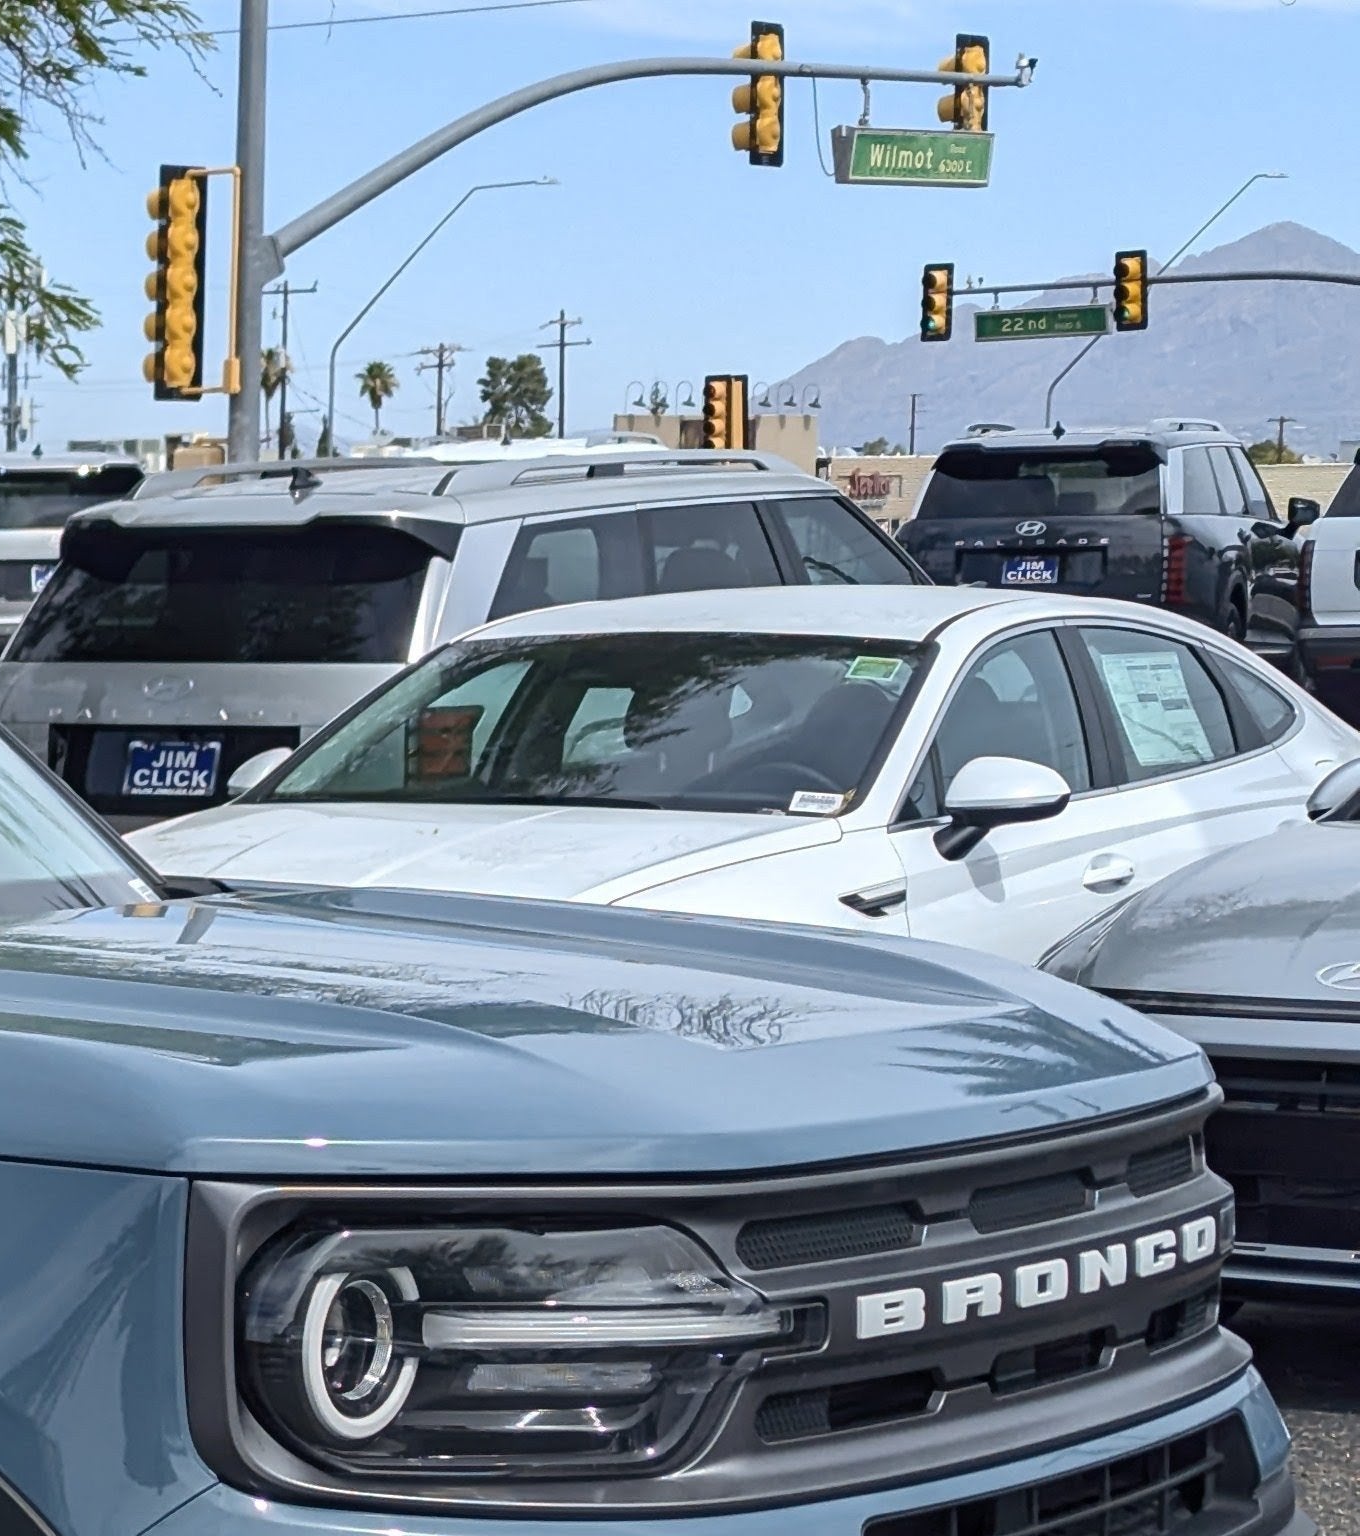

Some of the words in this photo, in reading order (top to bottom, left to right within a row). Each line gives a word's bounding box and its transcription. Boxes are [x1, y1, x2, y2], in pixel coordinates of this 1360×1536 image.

[870, 143, 934, 170] Wilmot
[1001, 317, 1047, 332] 22nd
[954, 537, 1110, 547] PALISADE
[1016, 560, 1045, 571] JIM
[1006, 570, 1053, 581] CLICK
[47, 707, 300, 722] PALIAD
[151, 750, 198, 768] JIM
[133, 768, 209, 788] CLICK
[856, 1215, 1216, 1340] BRONCO
